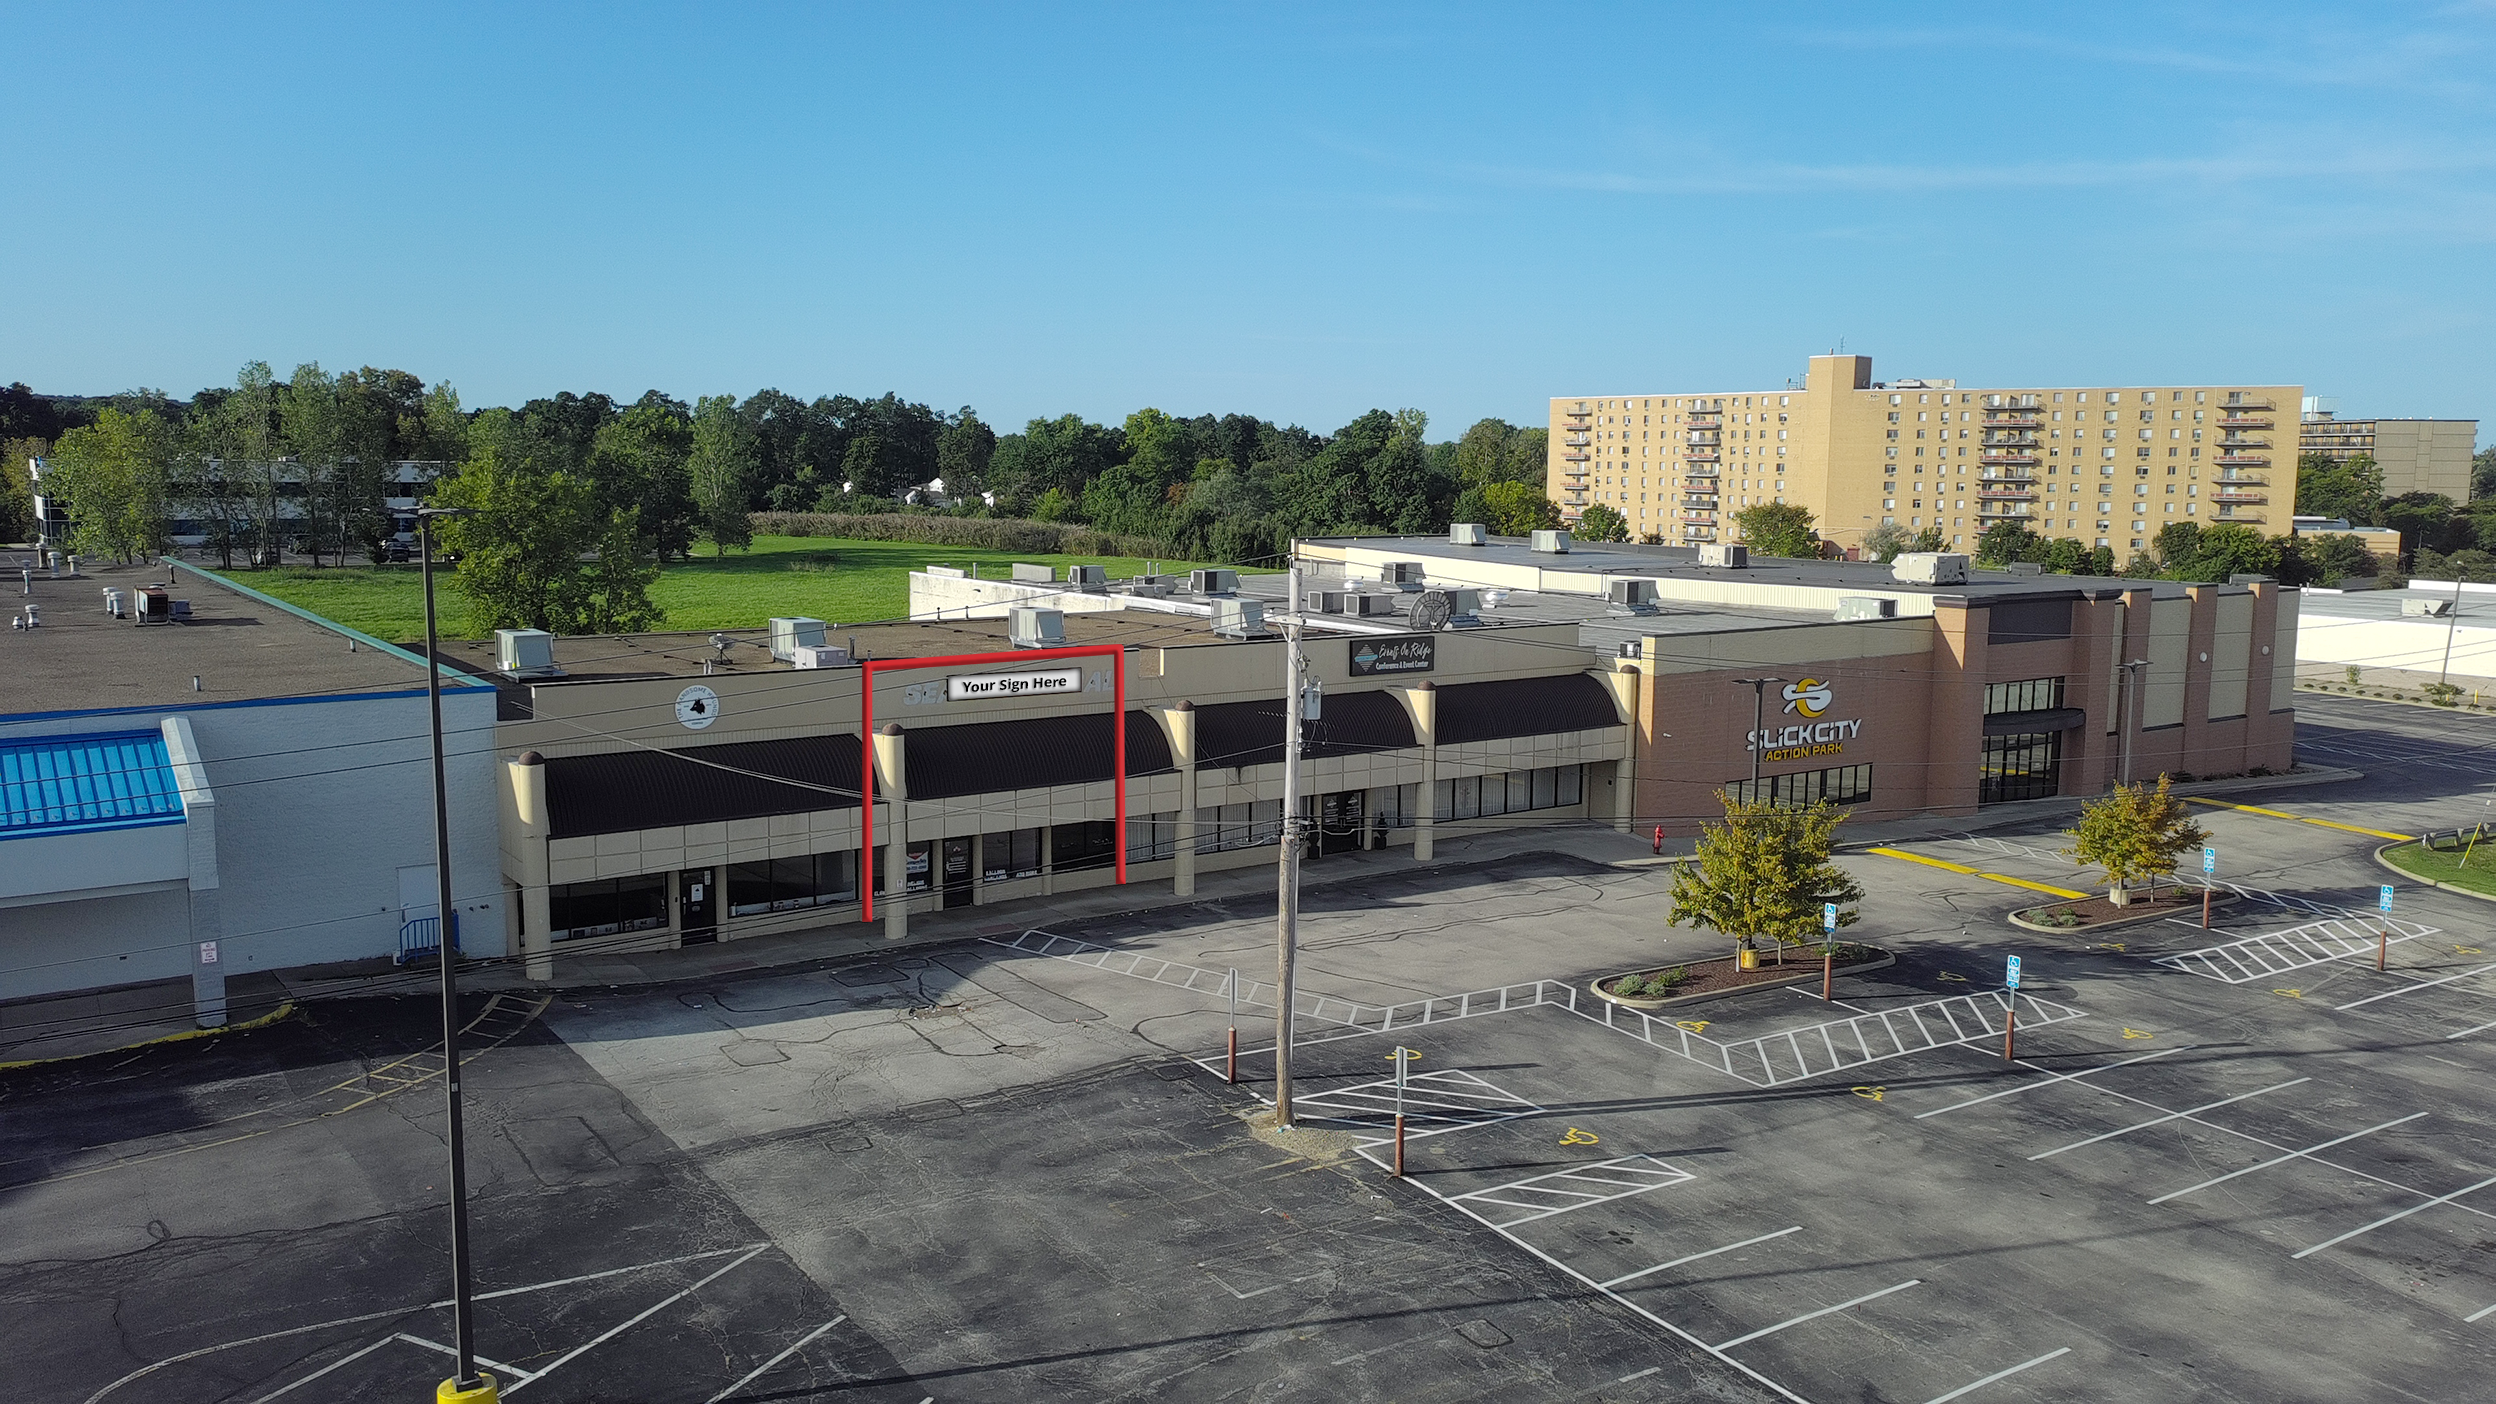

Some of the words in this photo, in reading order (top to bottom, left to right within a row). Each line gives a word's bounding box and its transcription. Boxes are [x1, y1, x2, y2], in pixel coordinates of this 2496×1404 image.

[1410, 641, 1432, 659] Ridge
[1376, 662, 1399, 670] Conference
[1403, 661, 1414, 669] Event
[1415, 660, 1429, 668] Center
[1765, 747, 1809, 762] ACTION
[1812, 742, 1844, 756] PARK
